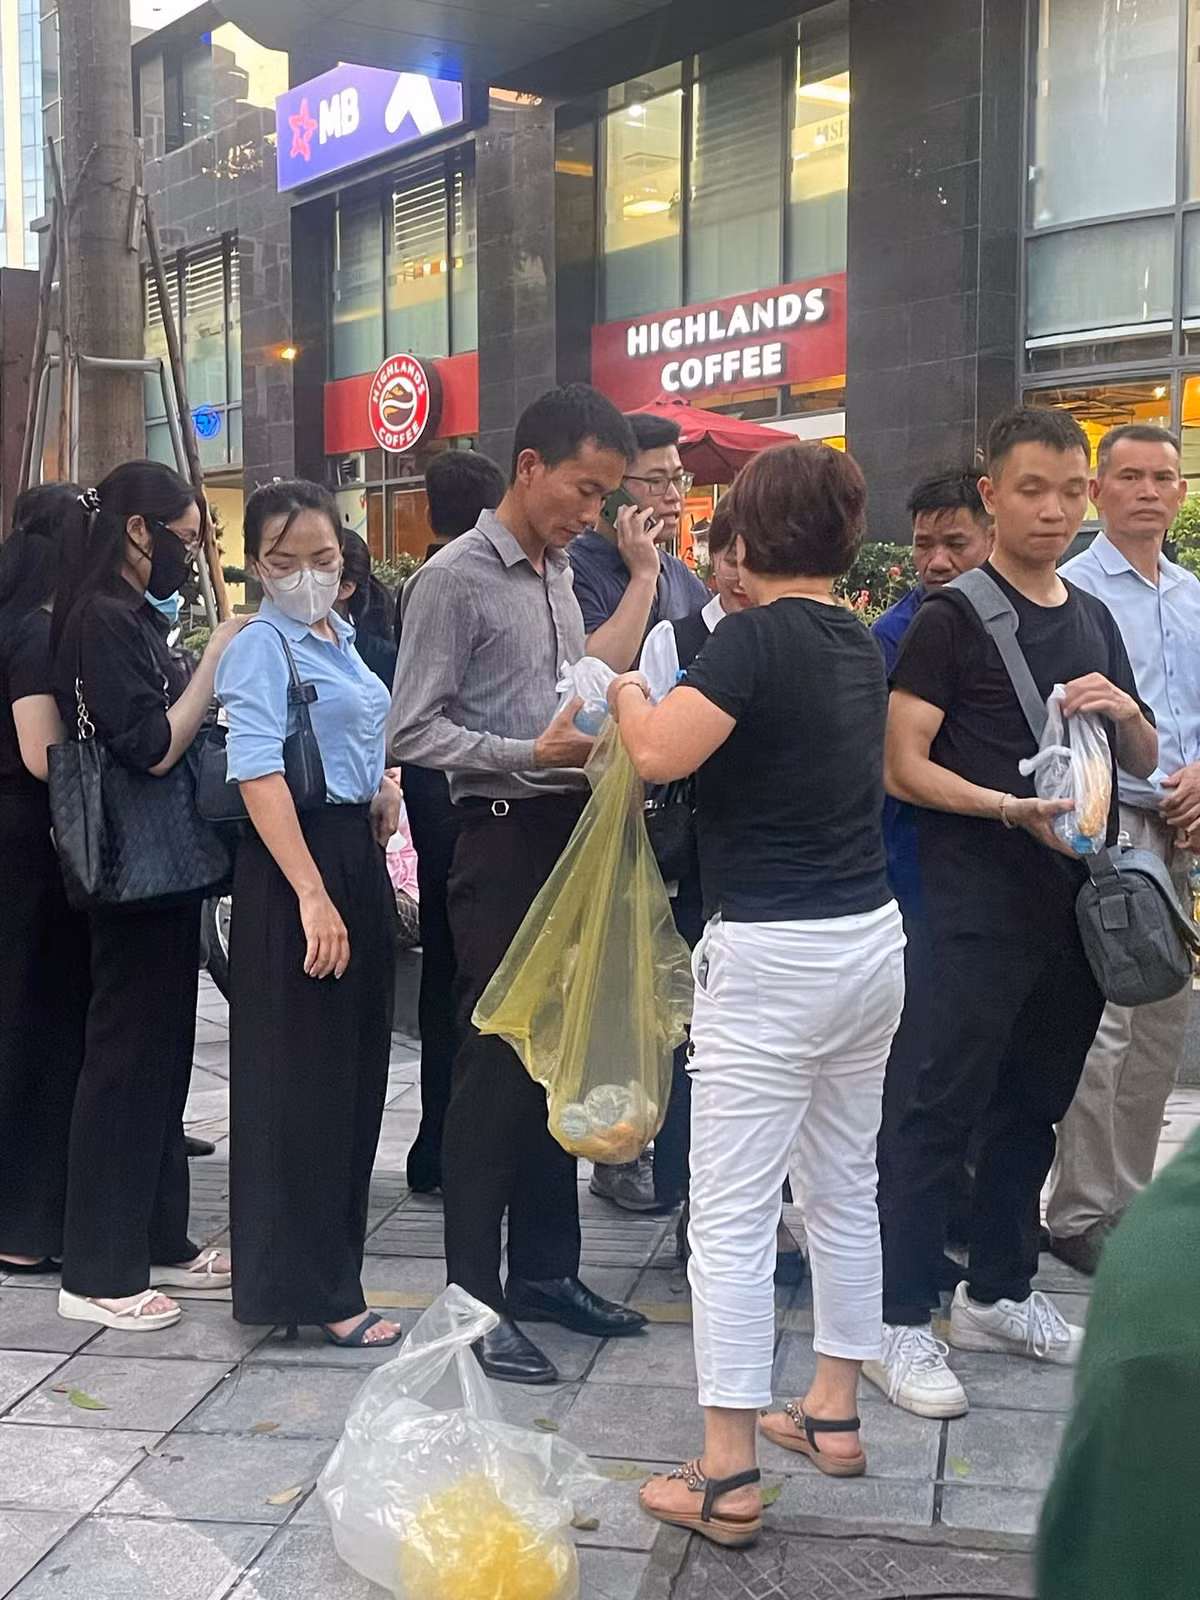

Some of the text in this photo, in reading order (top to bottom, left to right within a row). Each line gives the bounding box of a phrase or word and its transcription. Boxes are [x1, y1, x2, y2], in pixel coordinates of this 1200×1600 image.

[319, 87, 359, 145] MB
[627, 288, 825, 356] HIGHLANDS
[372, 361, 426, 404] HIGHLANDS
[661, 342, 782, 391] COFFEE
[378, 421, 421, 447] COFFEE
